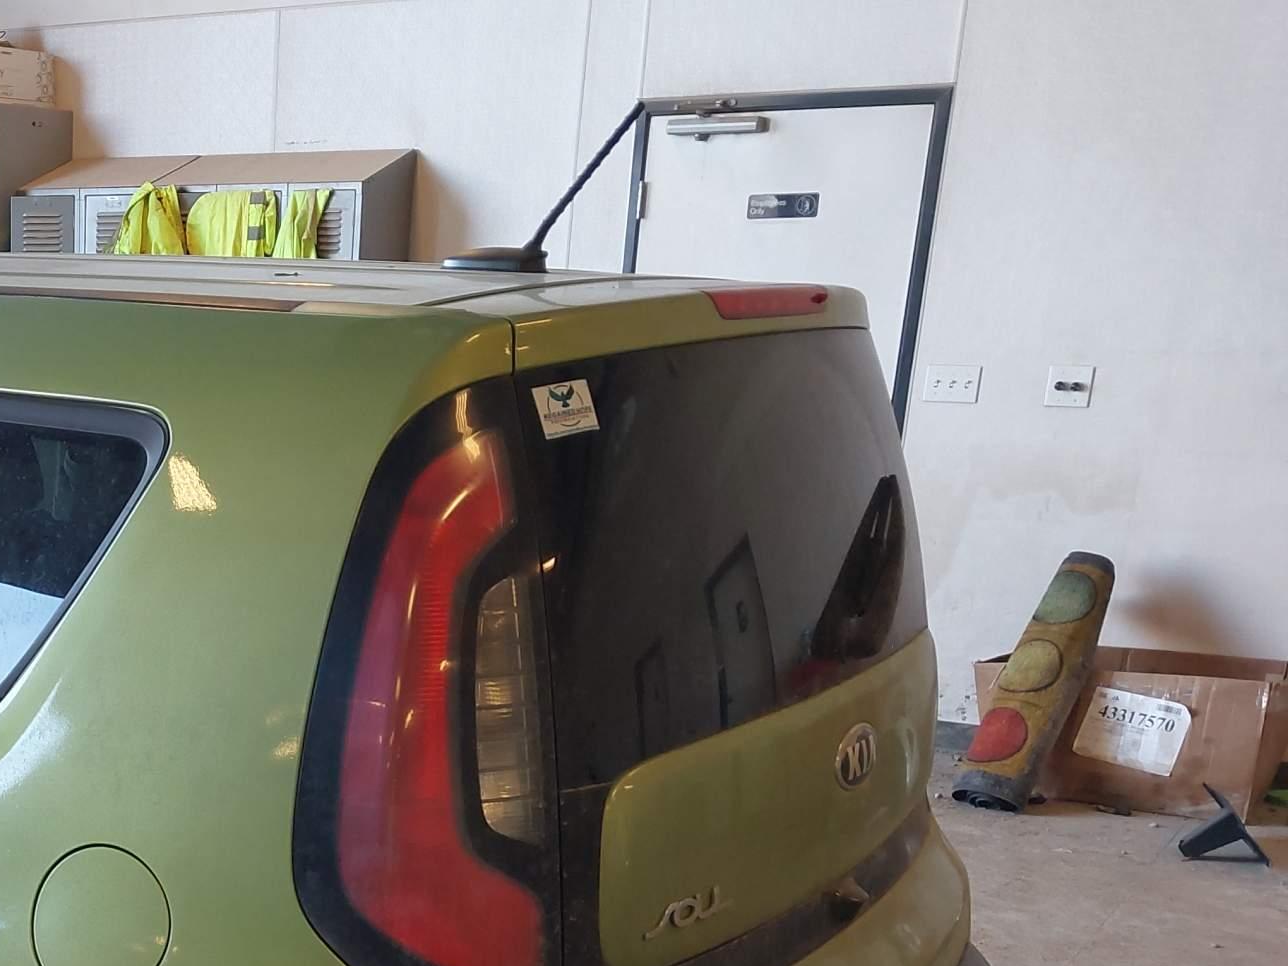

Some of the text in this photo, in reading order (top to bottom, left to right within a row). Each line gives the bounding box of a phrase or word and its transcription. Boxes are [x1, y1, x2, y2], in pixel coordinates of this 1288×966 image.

[749, 207, 766, 216] Only
[1098, 704, 1175, 733] 43317570
[846, 734, 874, 781] KIA
